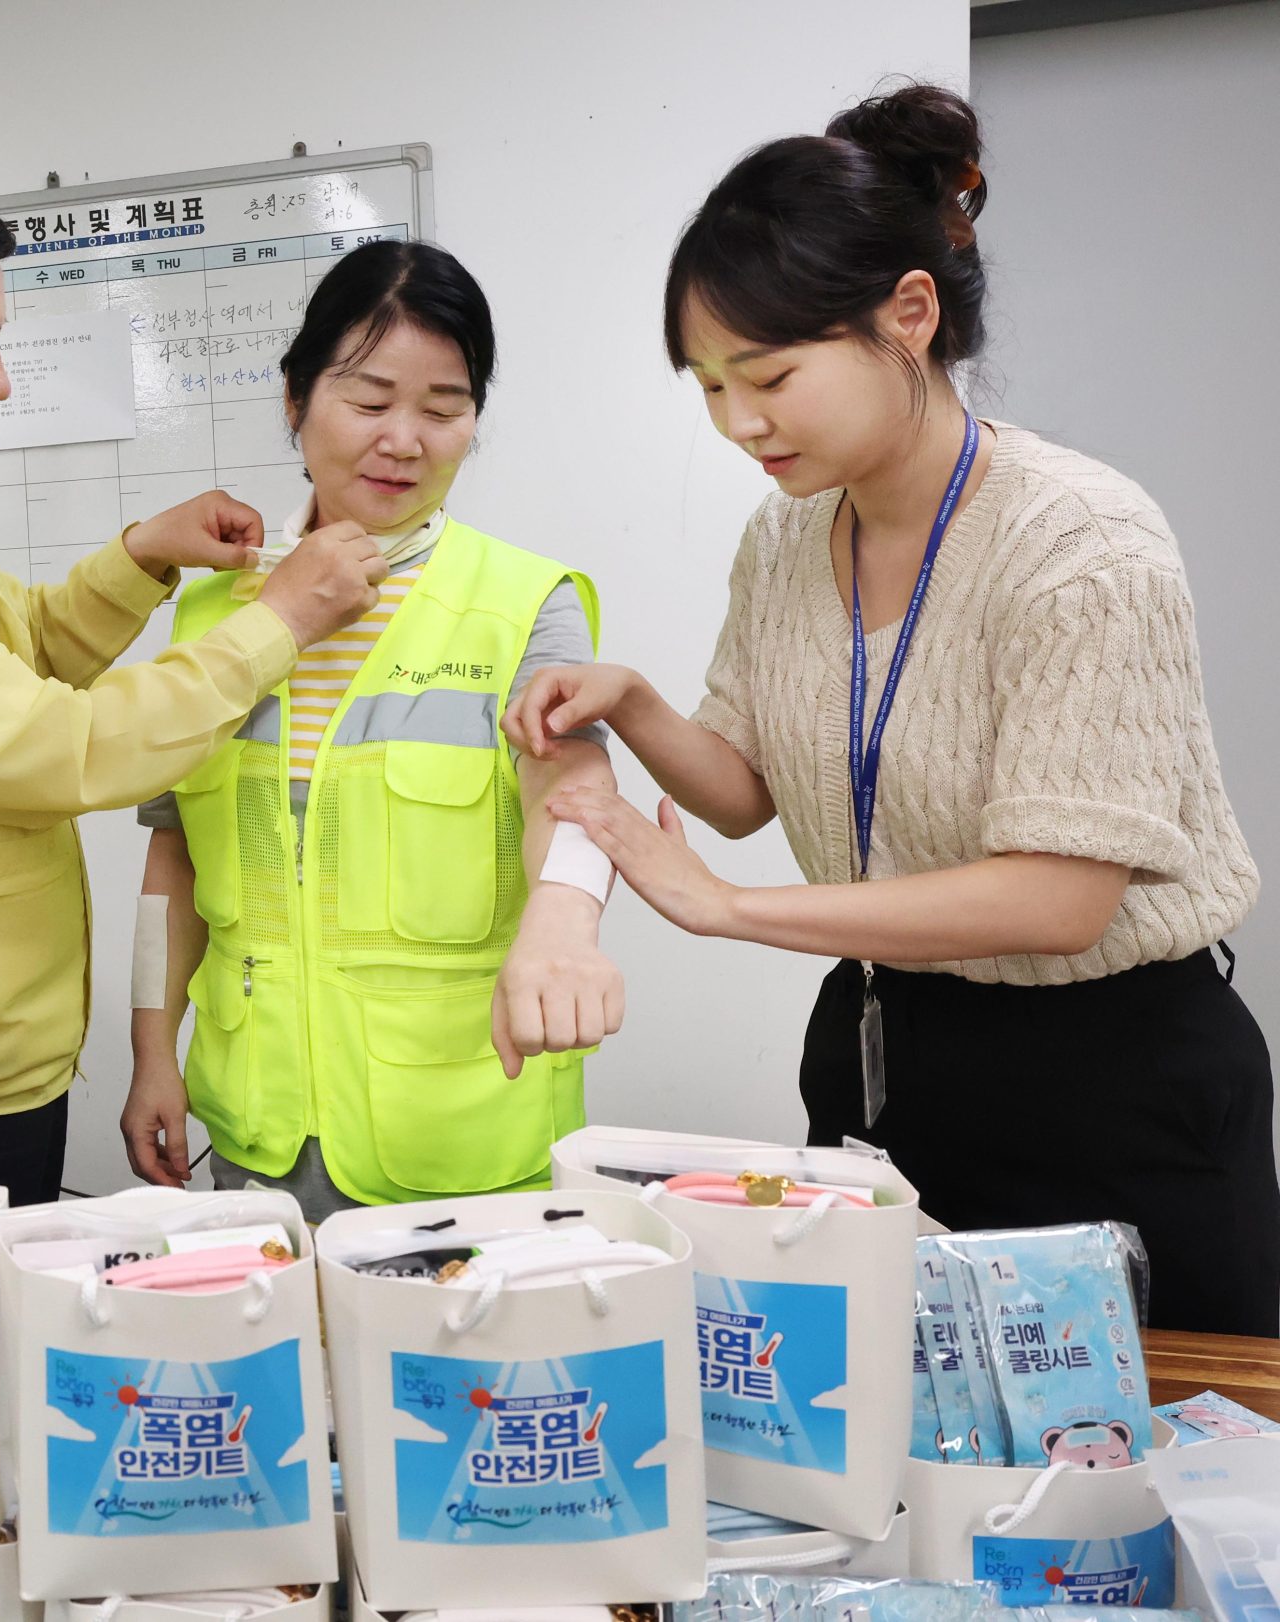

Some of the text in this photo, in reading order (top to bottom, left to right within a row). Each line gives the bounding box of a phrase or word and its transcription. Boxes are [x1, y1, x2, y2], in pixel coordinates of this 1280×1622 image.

[89, 209, 110, 233] 및
[126, 197, 204, 228] 계획표
[27, 224, 202, 254] EVENTS OF THE MONTH
[331, 236, 345, 251] 토
[131, 258, 181, 273] 목 THU
[232, 246, 277, 263] 금 FRI
[36, 269, 85, 284] 수 WED
[470, 665, 493, 680] 동구
[1002, 1322, 1046, 1347] 리예
[1008, 1346, 1092, 1374] 쿨링시트
[144, 1412, 223, 1448] 폭염
[497, 1410, 579, 1451] 폭염
[118, 1448, 245, 1478] 안전키트
[472, 1448, 601, 1483] 안전키트
